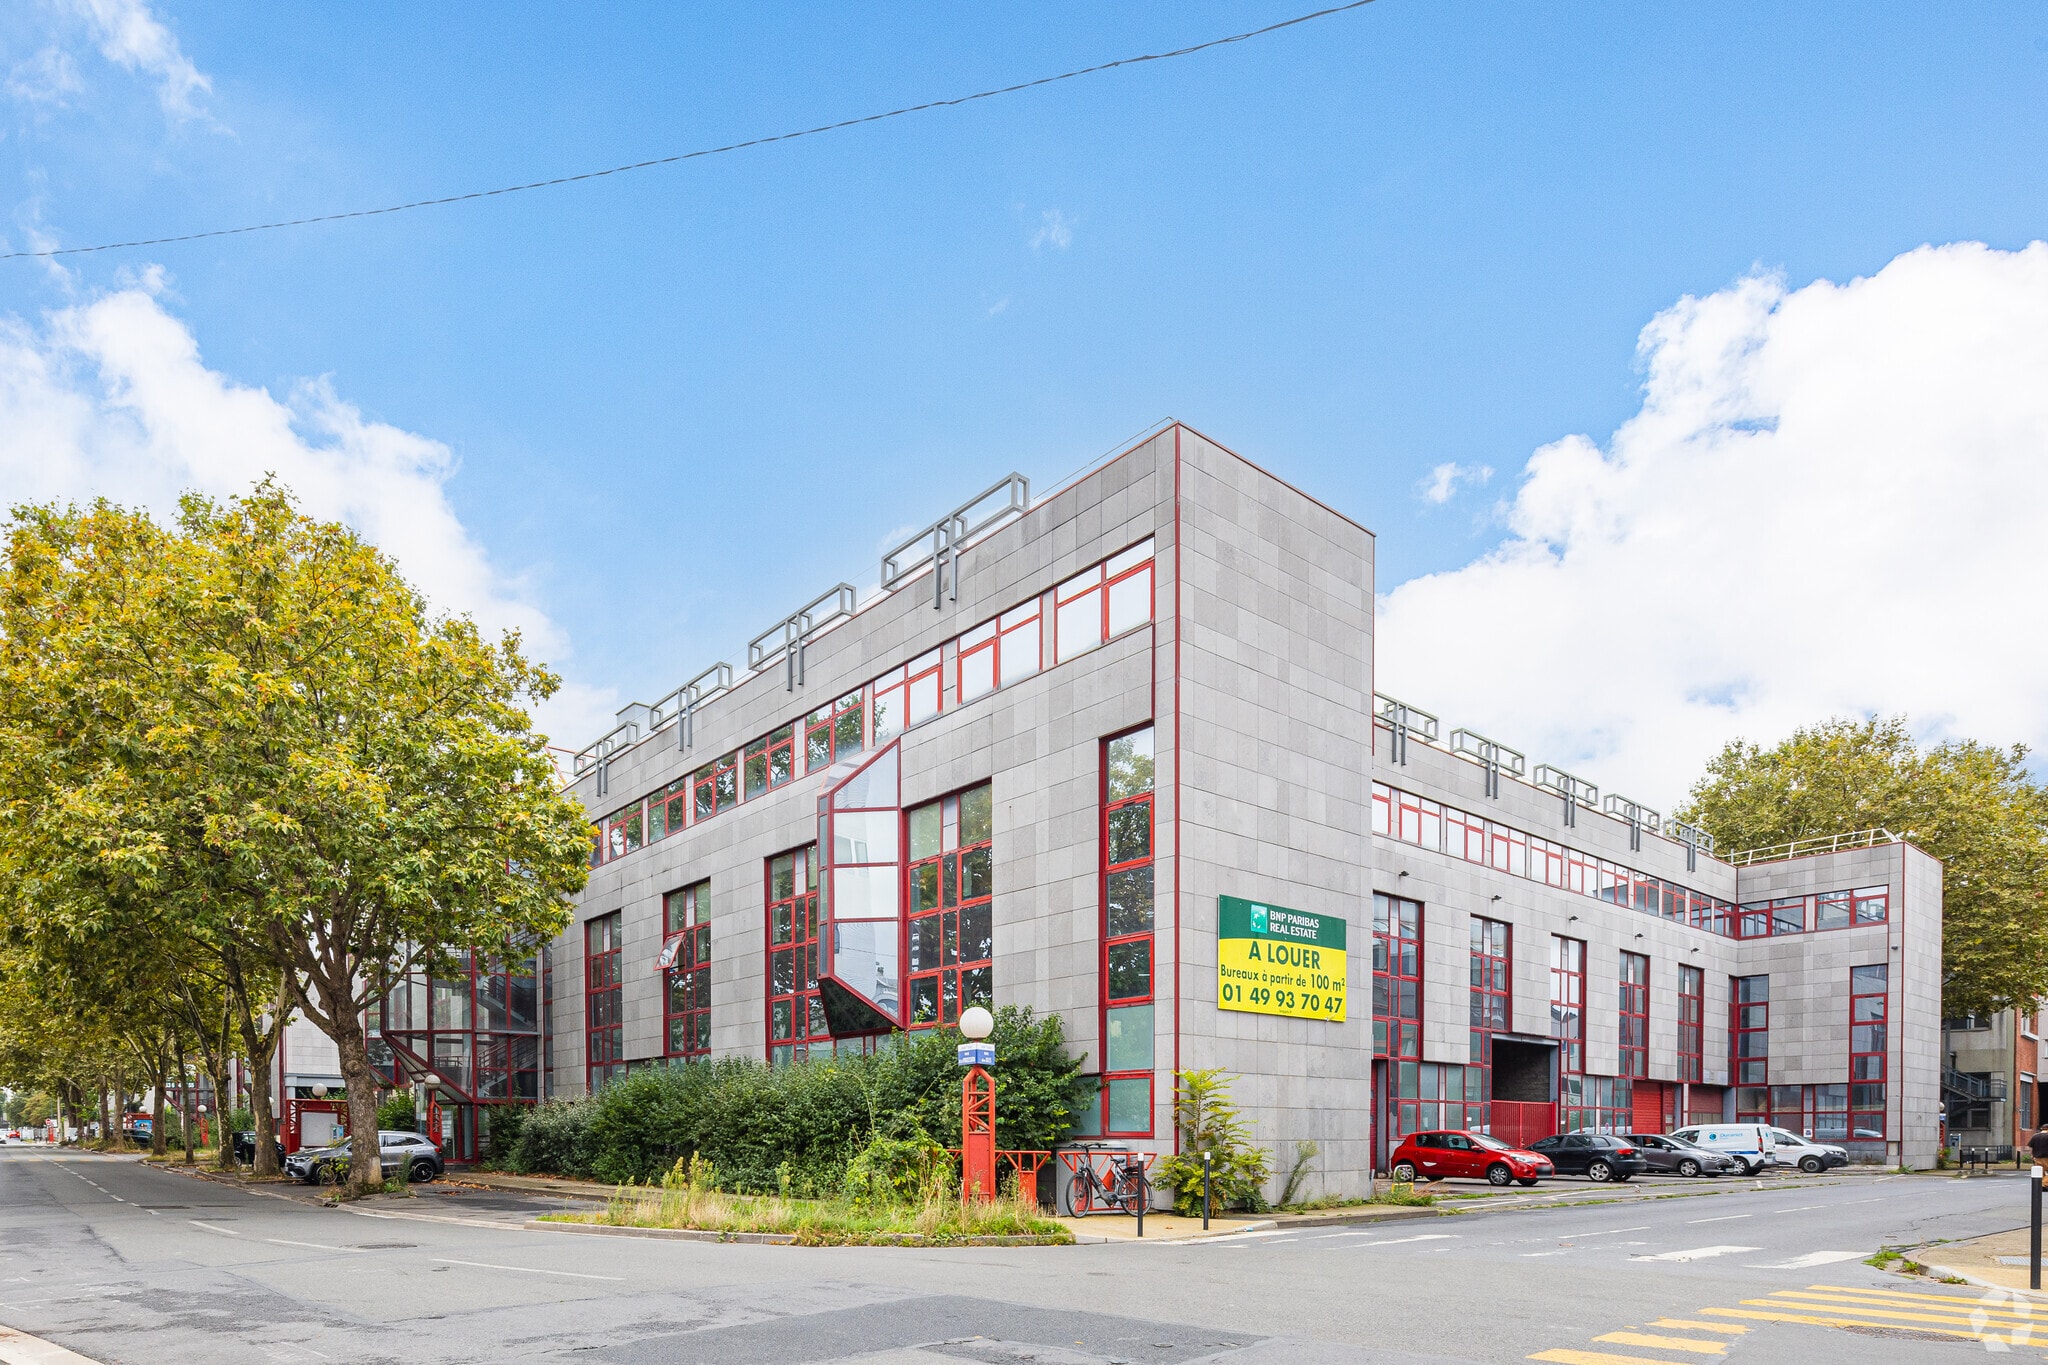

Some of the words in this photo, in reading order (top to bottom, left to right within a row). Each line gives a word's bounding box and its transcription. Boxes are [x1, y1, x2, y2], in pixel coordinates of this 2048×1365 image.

[1270, 910, 1286, 922] BNP
[1288, 914, 1319, 929] PARIBAS
[1270, 922, 1290, 935] REAL
[1290, 927, 1317, 940] ESTATE
[1248, 941, 1262, 961] A
[1268, 943, 1321, 970] LOUER
[1221, 964, 1259, 981] Bureaux
[1262, 969, 1268, 982] à
[1270, 972, 1293, 986] partir
[1296, 973, 1306, 987] de
[1311, 973, 1330, 990] 100
[1222, 983, 1241, 1002] 01
[1250, 987, 1270, 1006] 49
[1275, 990, 1295, 1009] 93
[1301, 993, 1320, 1011] 70
[1324, 997, 1343, 1014] 47
